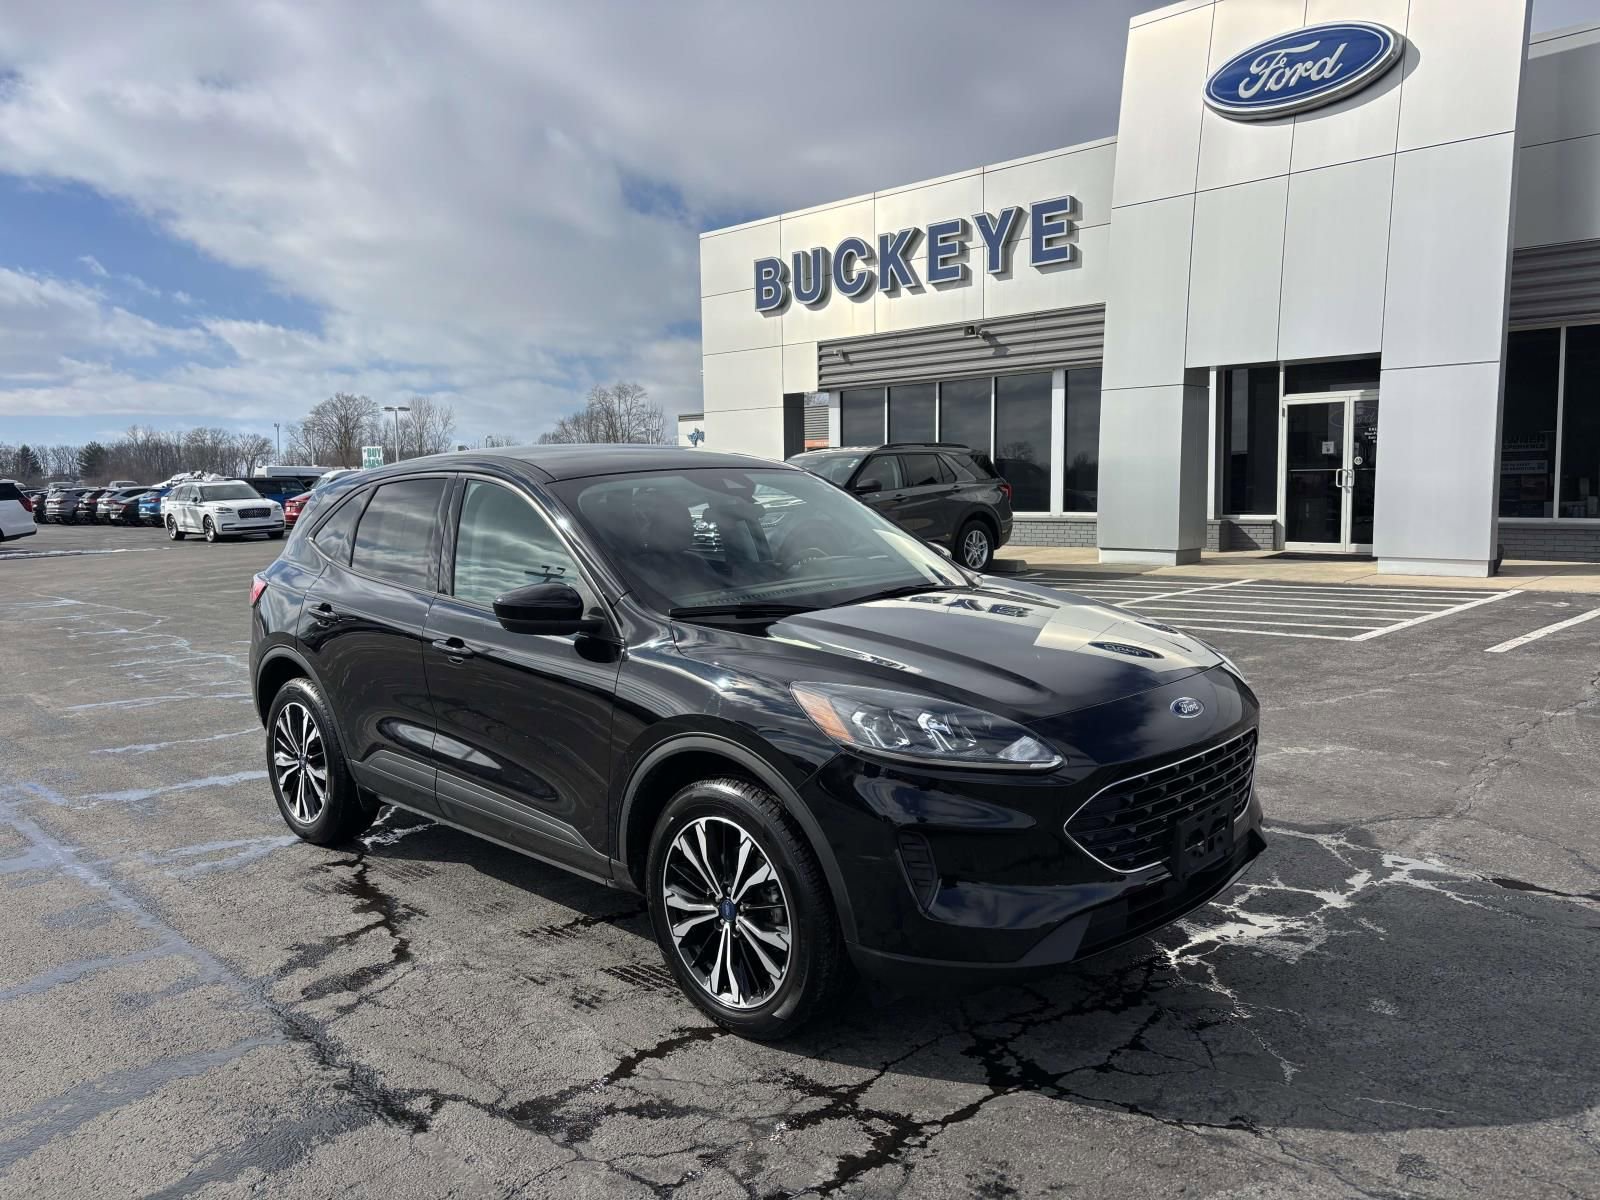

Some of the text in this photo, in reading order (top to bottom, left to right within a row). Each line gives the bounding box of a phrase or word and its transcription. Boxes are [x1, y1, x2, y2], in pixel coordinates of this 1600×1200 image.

[1238, 40, 1349, 99] Ford
[754, 195, 1077, 312] BUCKEYE
[367, 447, 381, 458] BUY
[1179, 701, 1198, 713] Ford
